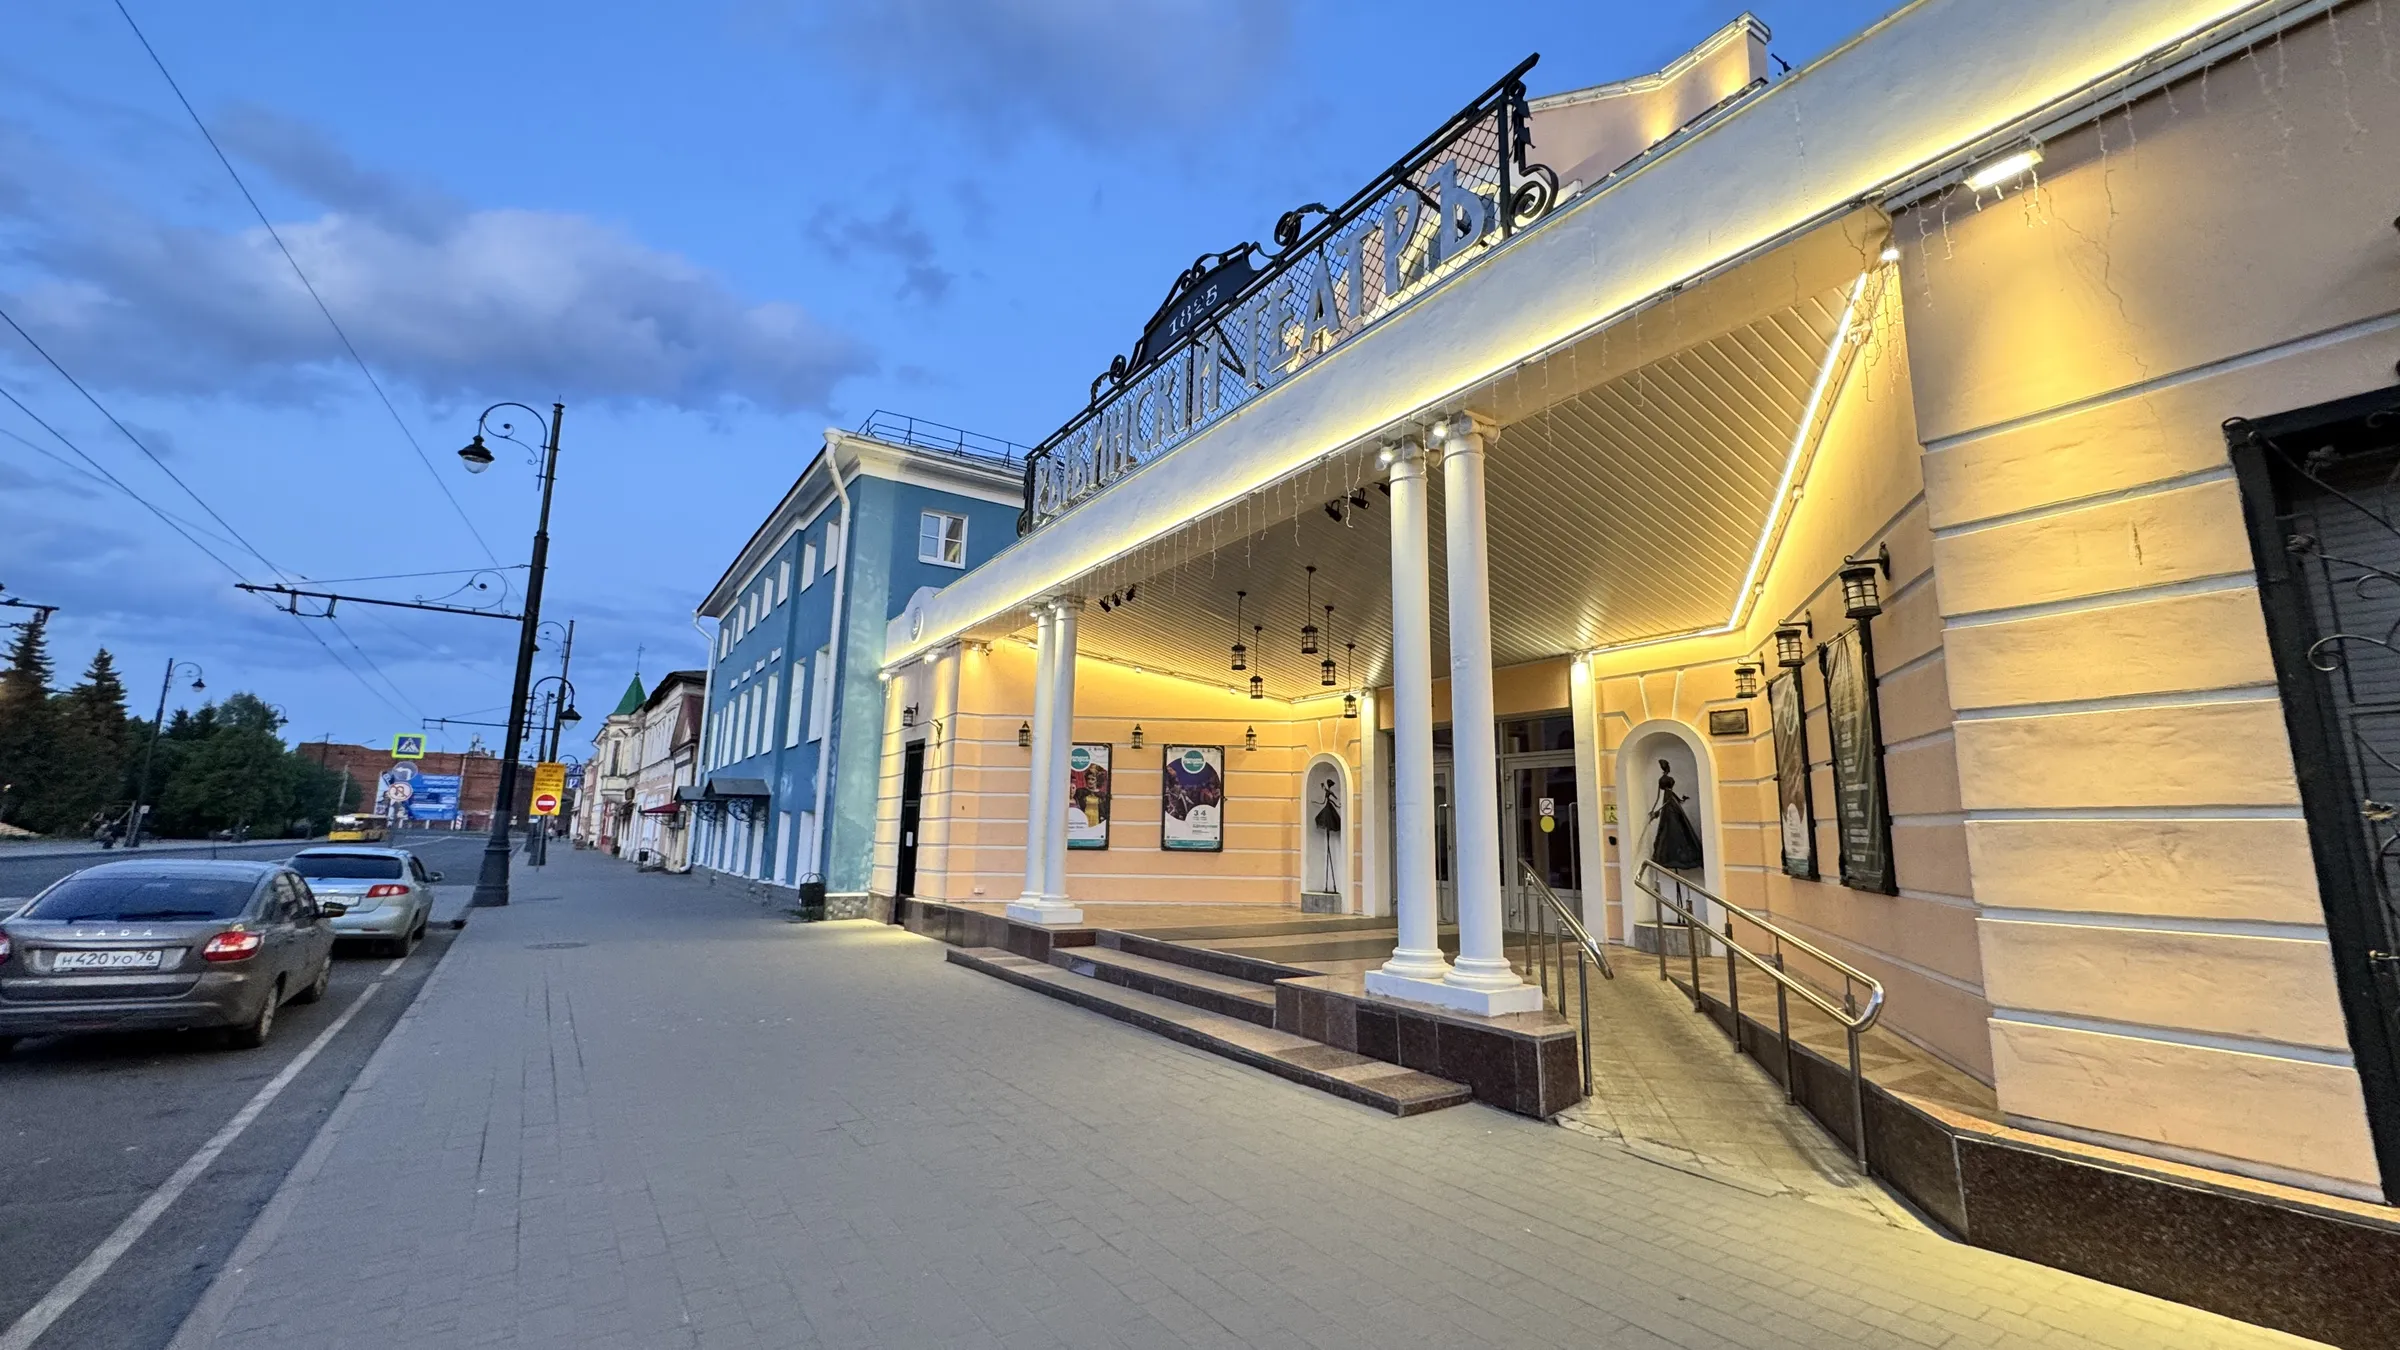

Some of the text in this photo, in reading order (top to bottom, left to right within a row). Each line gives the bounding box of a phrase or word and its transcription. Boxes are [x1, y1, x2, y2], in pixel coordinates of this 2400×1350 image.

[1236, 158, 1486, 388] ТЕАТРЪ
[1169, 284, 1218, 337] 1825
[76, 928, 153, 937] LADA
